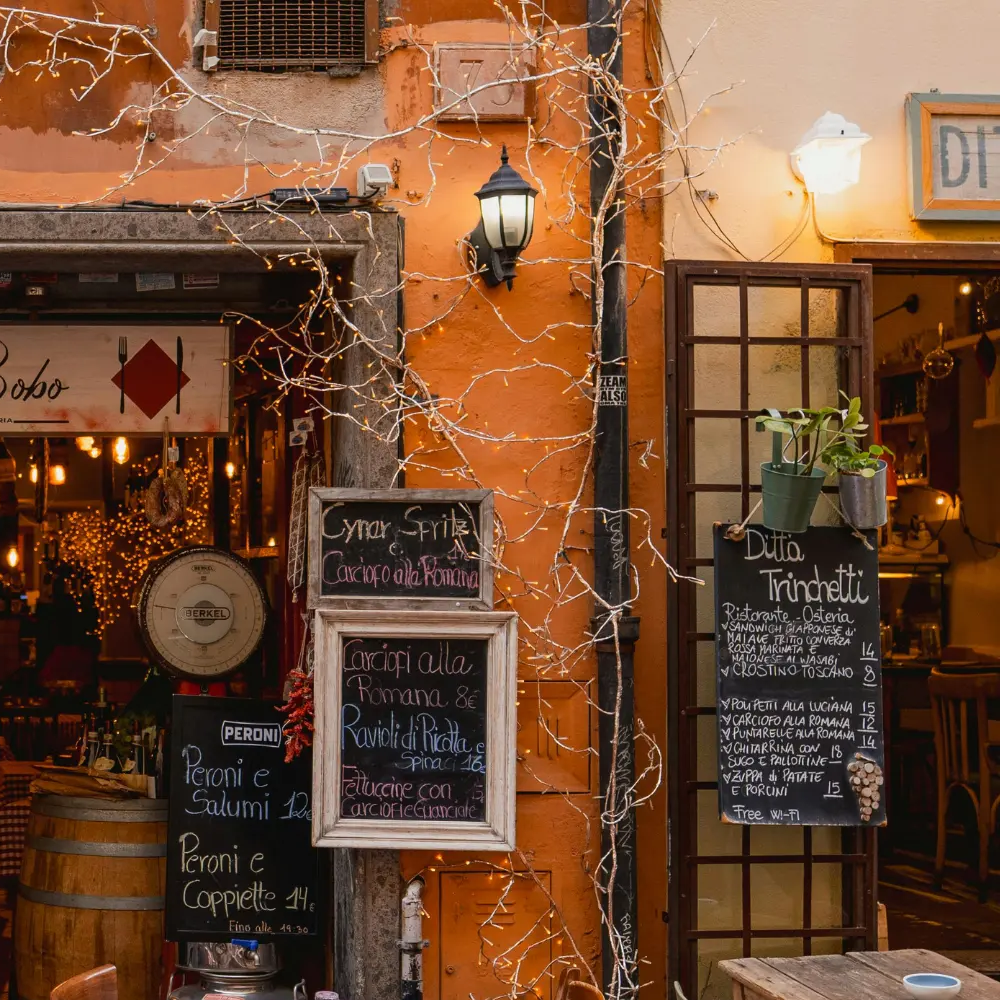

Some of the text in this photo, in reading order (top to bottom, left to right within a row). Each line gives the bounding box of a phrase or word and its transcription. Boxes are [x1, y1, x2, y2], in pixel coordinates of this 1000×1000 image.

[940, 125, 1000, 188] DI
[744, 528, 805, 562] Ditta
[322, 550, 479, 590] Carciofo alla Romana
[759, 563, 870, 604] Trinchetti
[185, 609, 226, 618] BERKEL
[722, 602, 790, 623] Ristorante
[802, 604, 855, 624] Osteria
[729, 620, 782, 634] SANDWICH
[727, 630, 769, 644] MAIALE
[728, 642, 756, 654] ROSSA
[862, 641, 875, 658] 14
[343, 639, 473, 678] Carciofi alla
[733, 660, 854, 679] CROSTINO TOSCANO
[864, 666, 876, 683] 8
[346, 674, 448, 708] Romana
[782, 700, 804, 712] ALLA
[862, 701, 875, 714] 15
[341, 703, 485, 754] Ravioli di Ricotta e
[732, 712, 850, 729] CARCIOFO ALLA ROMANA
[862, 716, 875, 730] 12
[224, 725, 280, 743] PERONI
[732, 726, 855, 741] PUNTARELLE ALLA ROMANA
[862, 735, 875, 747] 14
[831, 744, 843, 759] 18
[182, 744, 270, 788] Peroni e
[399, 751, 457, 773] Spinaci
[728, 755, 755, 768] SUGO
[731, 769, 763, 783] ZUPPA
[783, 768, 825, 783] PATATE
[418, 782, 452, 800] con
[731, 785, 740, 796] E
[827, 780, 840, 794] 15
[185, 789, 270, 820] Salumi
[732, 804, 764, 820] Free
[179, 832, 265, 874] Peroni e
[183, 879, 277, 918] Coppiette
[229, 920, 251, 933] Fino
